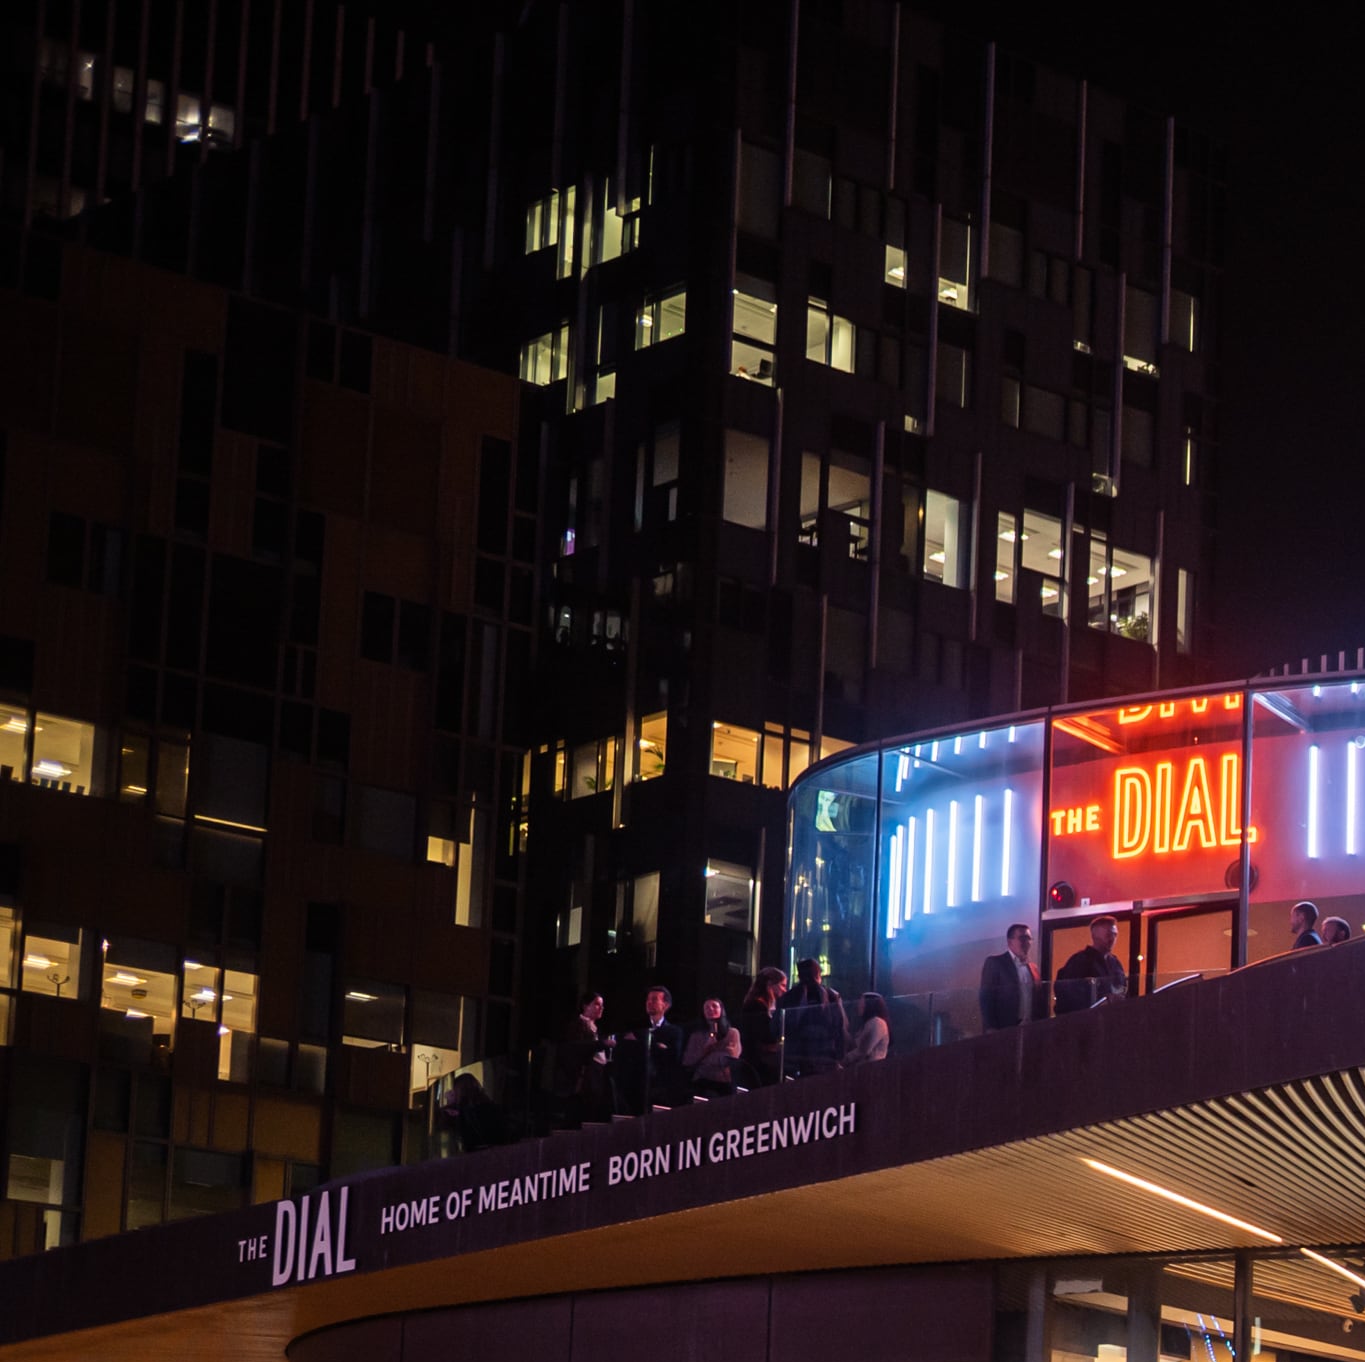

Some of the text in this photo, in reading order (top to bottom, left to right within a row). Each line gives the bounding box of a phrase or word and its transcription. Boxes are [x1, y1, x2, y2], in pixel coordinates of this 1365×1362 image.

[1051, 753, 1259, 860] THE DIAL
[238, 1102, 856, 1287] THE DIAL HOME OF MEANTIME BORN IN GREENWICH
